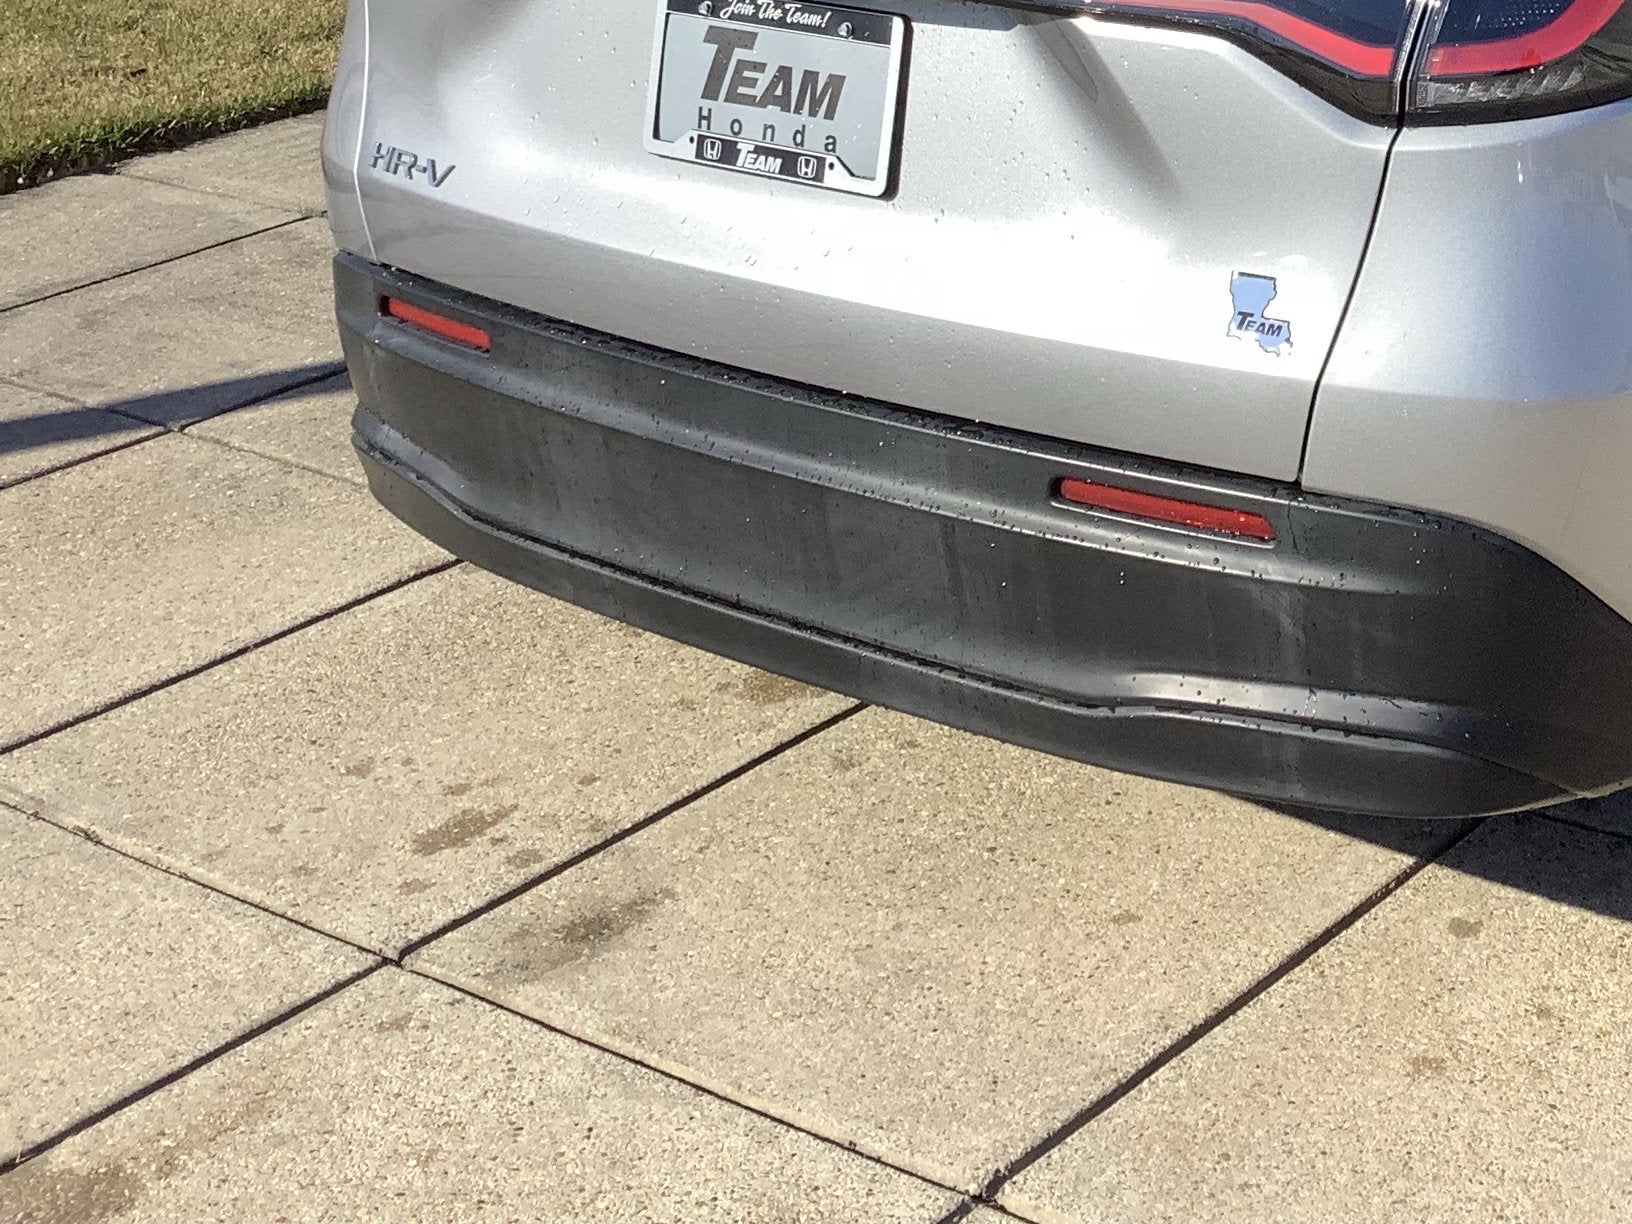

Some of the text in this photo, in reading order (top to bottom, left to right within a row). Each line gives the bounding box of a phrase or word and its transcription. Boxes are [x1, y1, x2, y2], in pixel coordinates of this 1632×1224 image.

[757, 0, 783, 20] The
[784, 2, 832, 28] Team!
[700, 25, 847, 121] TEAM
[369, 142, 457, 188] HR-V
[736, 143, 783, 174] TEAM
[1236, 310, 1283, 337] TEAM
